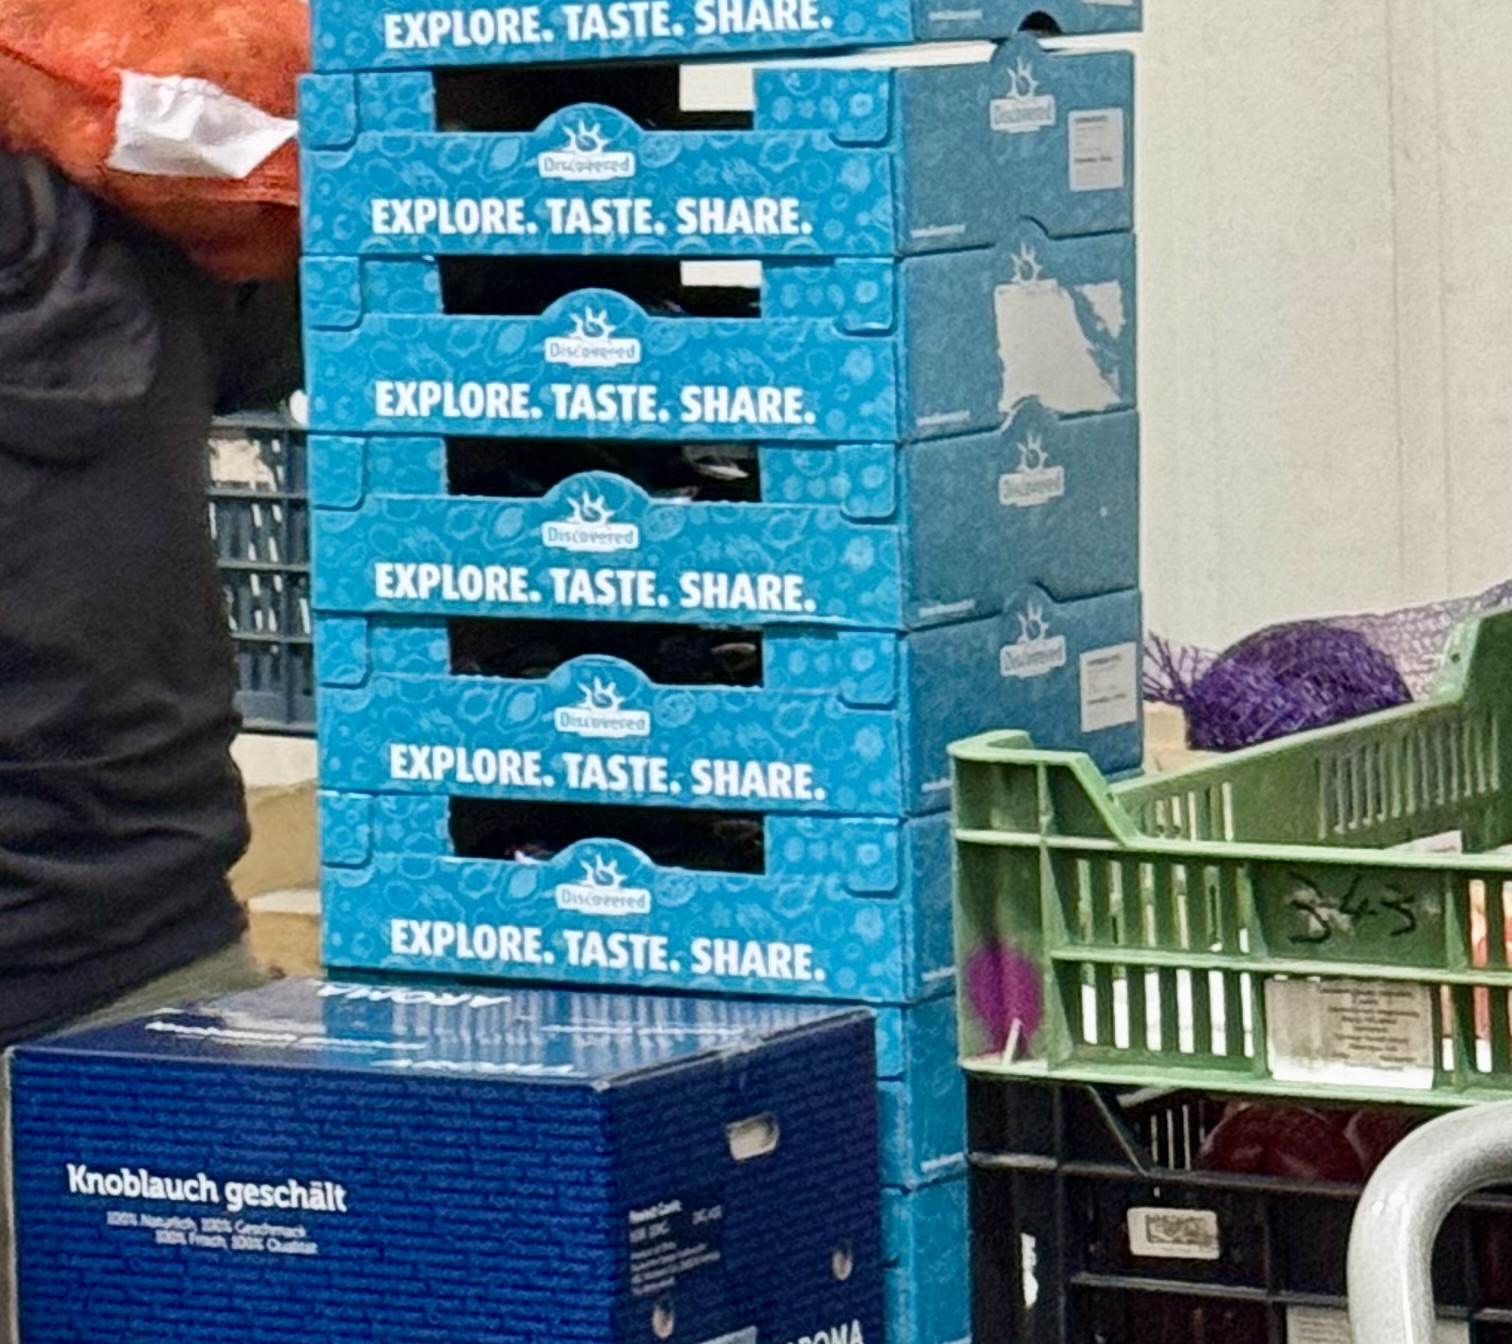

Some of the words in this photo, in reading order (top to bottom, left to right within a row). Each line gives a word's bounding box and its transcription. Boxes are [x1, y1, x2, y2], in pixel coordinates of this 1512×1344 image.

[384, 6, 554, 49] EXPLORE.
[562, 0, 684, 41] TASTE.
[543, 155, 631, 173] Discovered
[372, 197, 537, 235] EXPLORE.
[546, 198, 666, 235] TASTE.
[676, 197, 813, 235] SHARE.
[549, 341, 637, 360] Discovered
[375, 380, 542, 419] EXPLORE.
[551, 383, 669, 422] TASTE.
[681, 385, 816, 424] SHARE.
[547, 526, 635, 545] Discovered
[375, 562, 541, 602] EXPLORE.
[550, 567, 669, 607] TASTE.
[679, 571, 816, 612] SHARE.
[560, 713, 647, 732] Discovered
[390, 744, 554, 787] EXPLORE.
[563, 751, 681, 793] TASTE.
[691, 758, 826, 801] SHARE.
[560, 888, 647, 909] Discovered
[390, 919, 555, 965] EXPLORE.
[563, 928, 680, 972] TASTE.
[691, 937, 826, 981] SHARE.
[66, 1162, 220, 1204] Knoblauch
[224, 1178, 348, 1212] geschält
